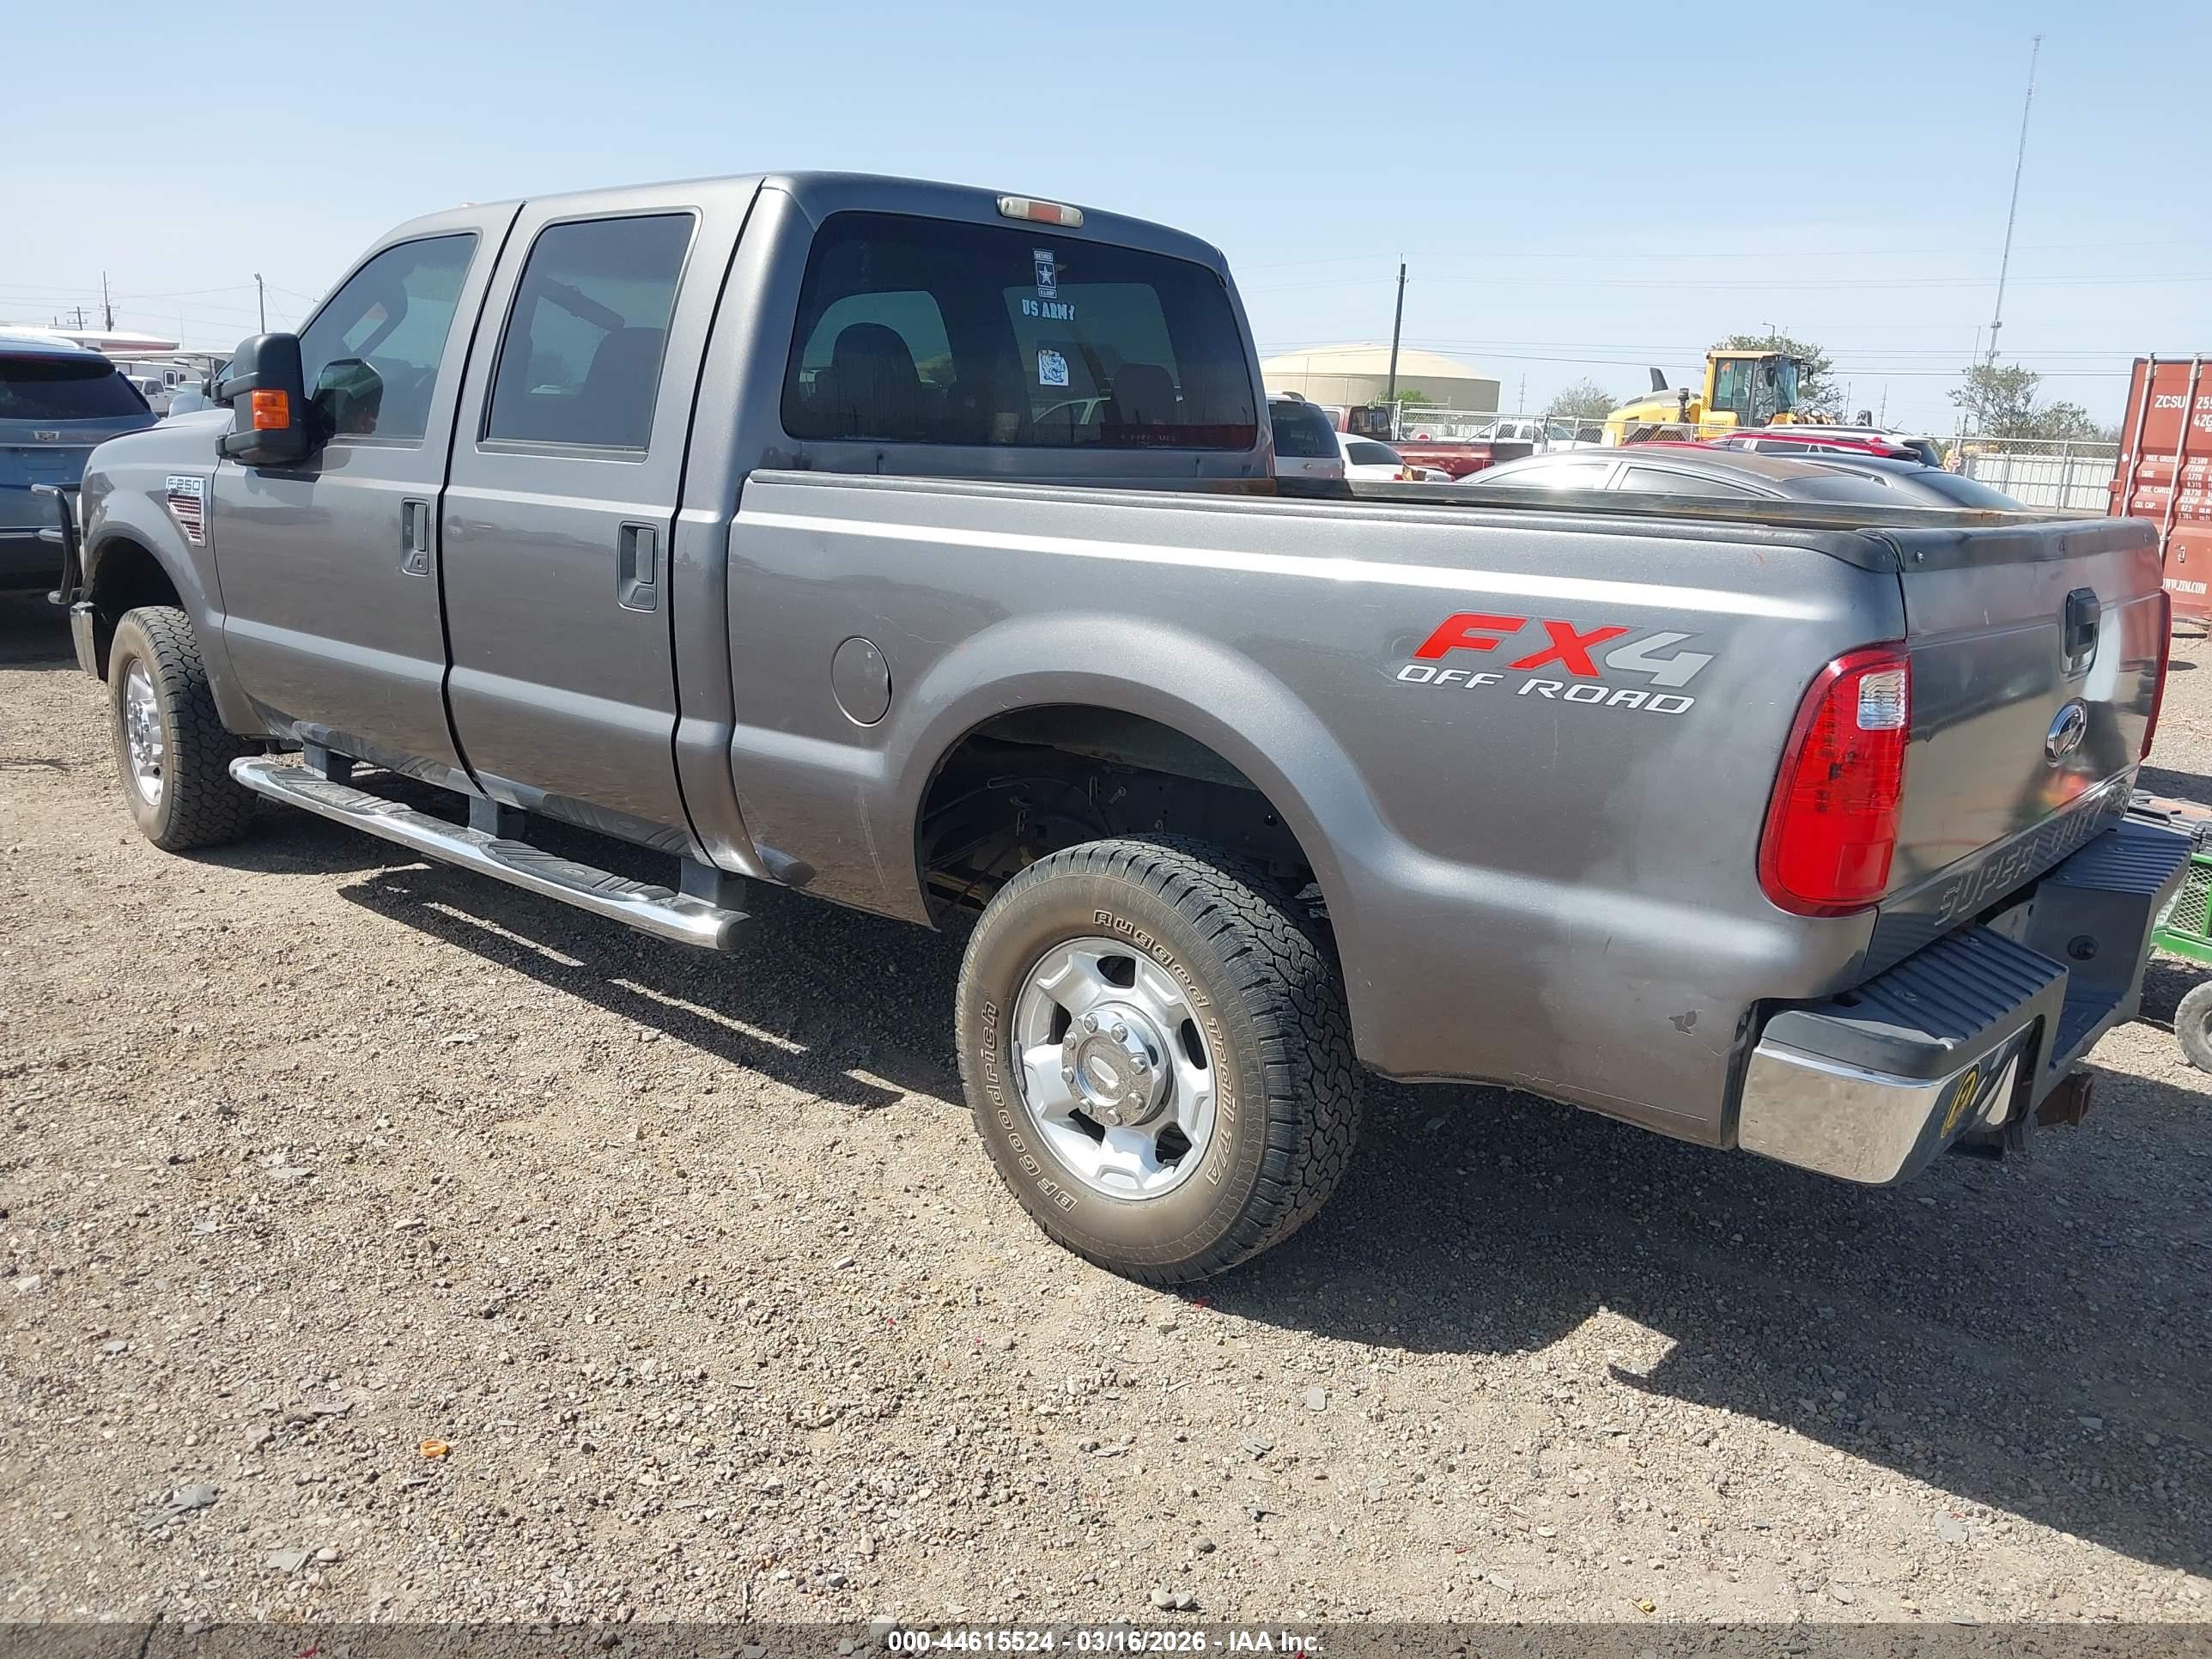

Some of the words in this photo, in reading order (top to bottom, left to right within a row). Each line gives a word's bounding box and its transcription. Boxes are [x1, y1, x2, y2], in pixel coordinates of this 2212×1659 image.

[1022, 299, 1039, 317] US
[1042, 301, 1075, 321] ARMY
[2154, 394, 2187, 409] ZCSU
[1412, 609, 1716, 688] FX4
[1396, 663, 1504, 690] OFF
[1516, 678, 1696, 714] ROAD
[1093, 908, 1210, 1009] Rugged
[1206, 1016, 1237, 1123] Trail
[1206, 1130, 1234, 1186] T/A
